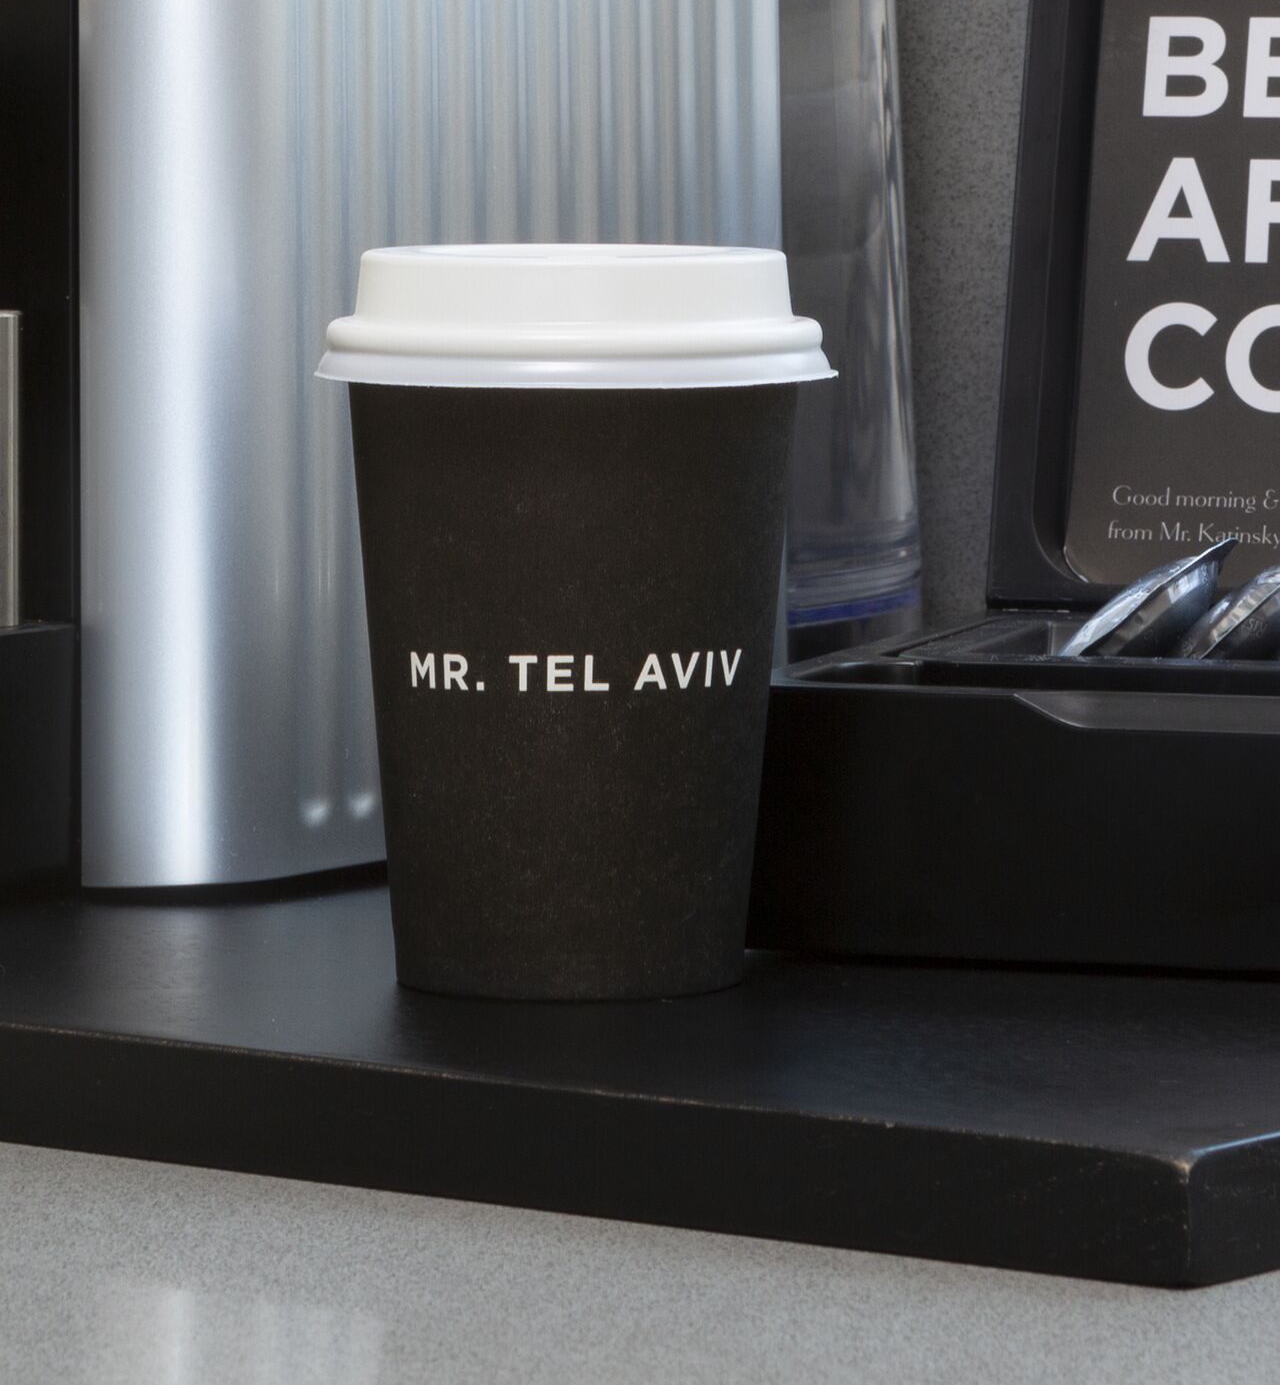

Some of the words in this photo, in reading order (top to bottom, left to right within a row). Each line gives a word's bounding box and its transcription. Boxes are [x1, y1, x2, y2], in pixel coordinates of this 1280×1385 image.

[1112, 484, 1170, 507] Good
[1176, 490, 1257, 514] morning
[1263, 488, 1280, 510] &
[1108, 519, 1153, 541] from
[1160, 521, 1191, 542] Mr.
[410, 651, 485, 692] MR.
[508, 654, 610, 692] TEL
[633, 648, 742, 691] AVIV
